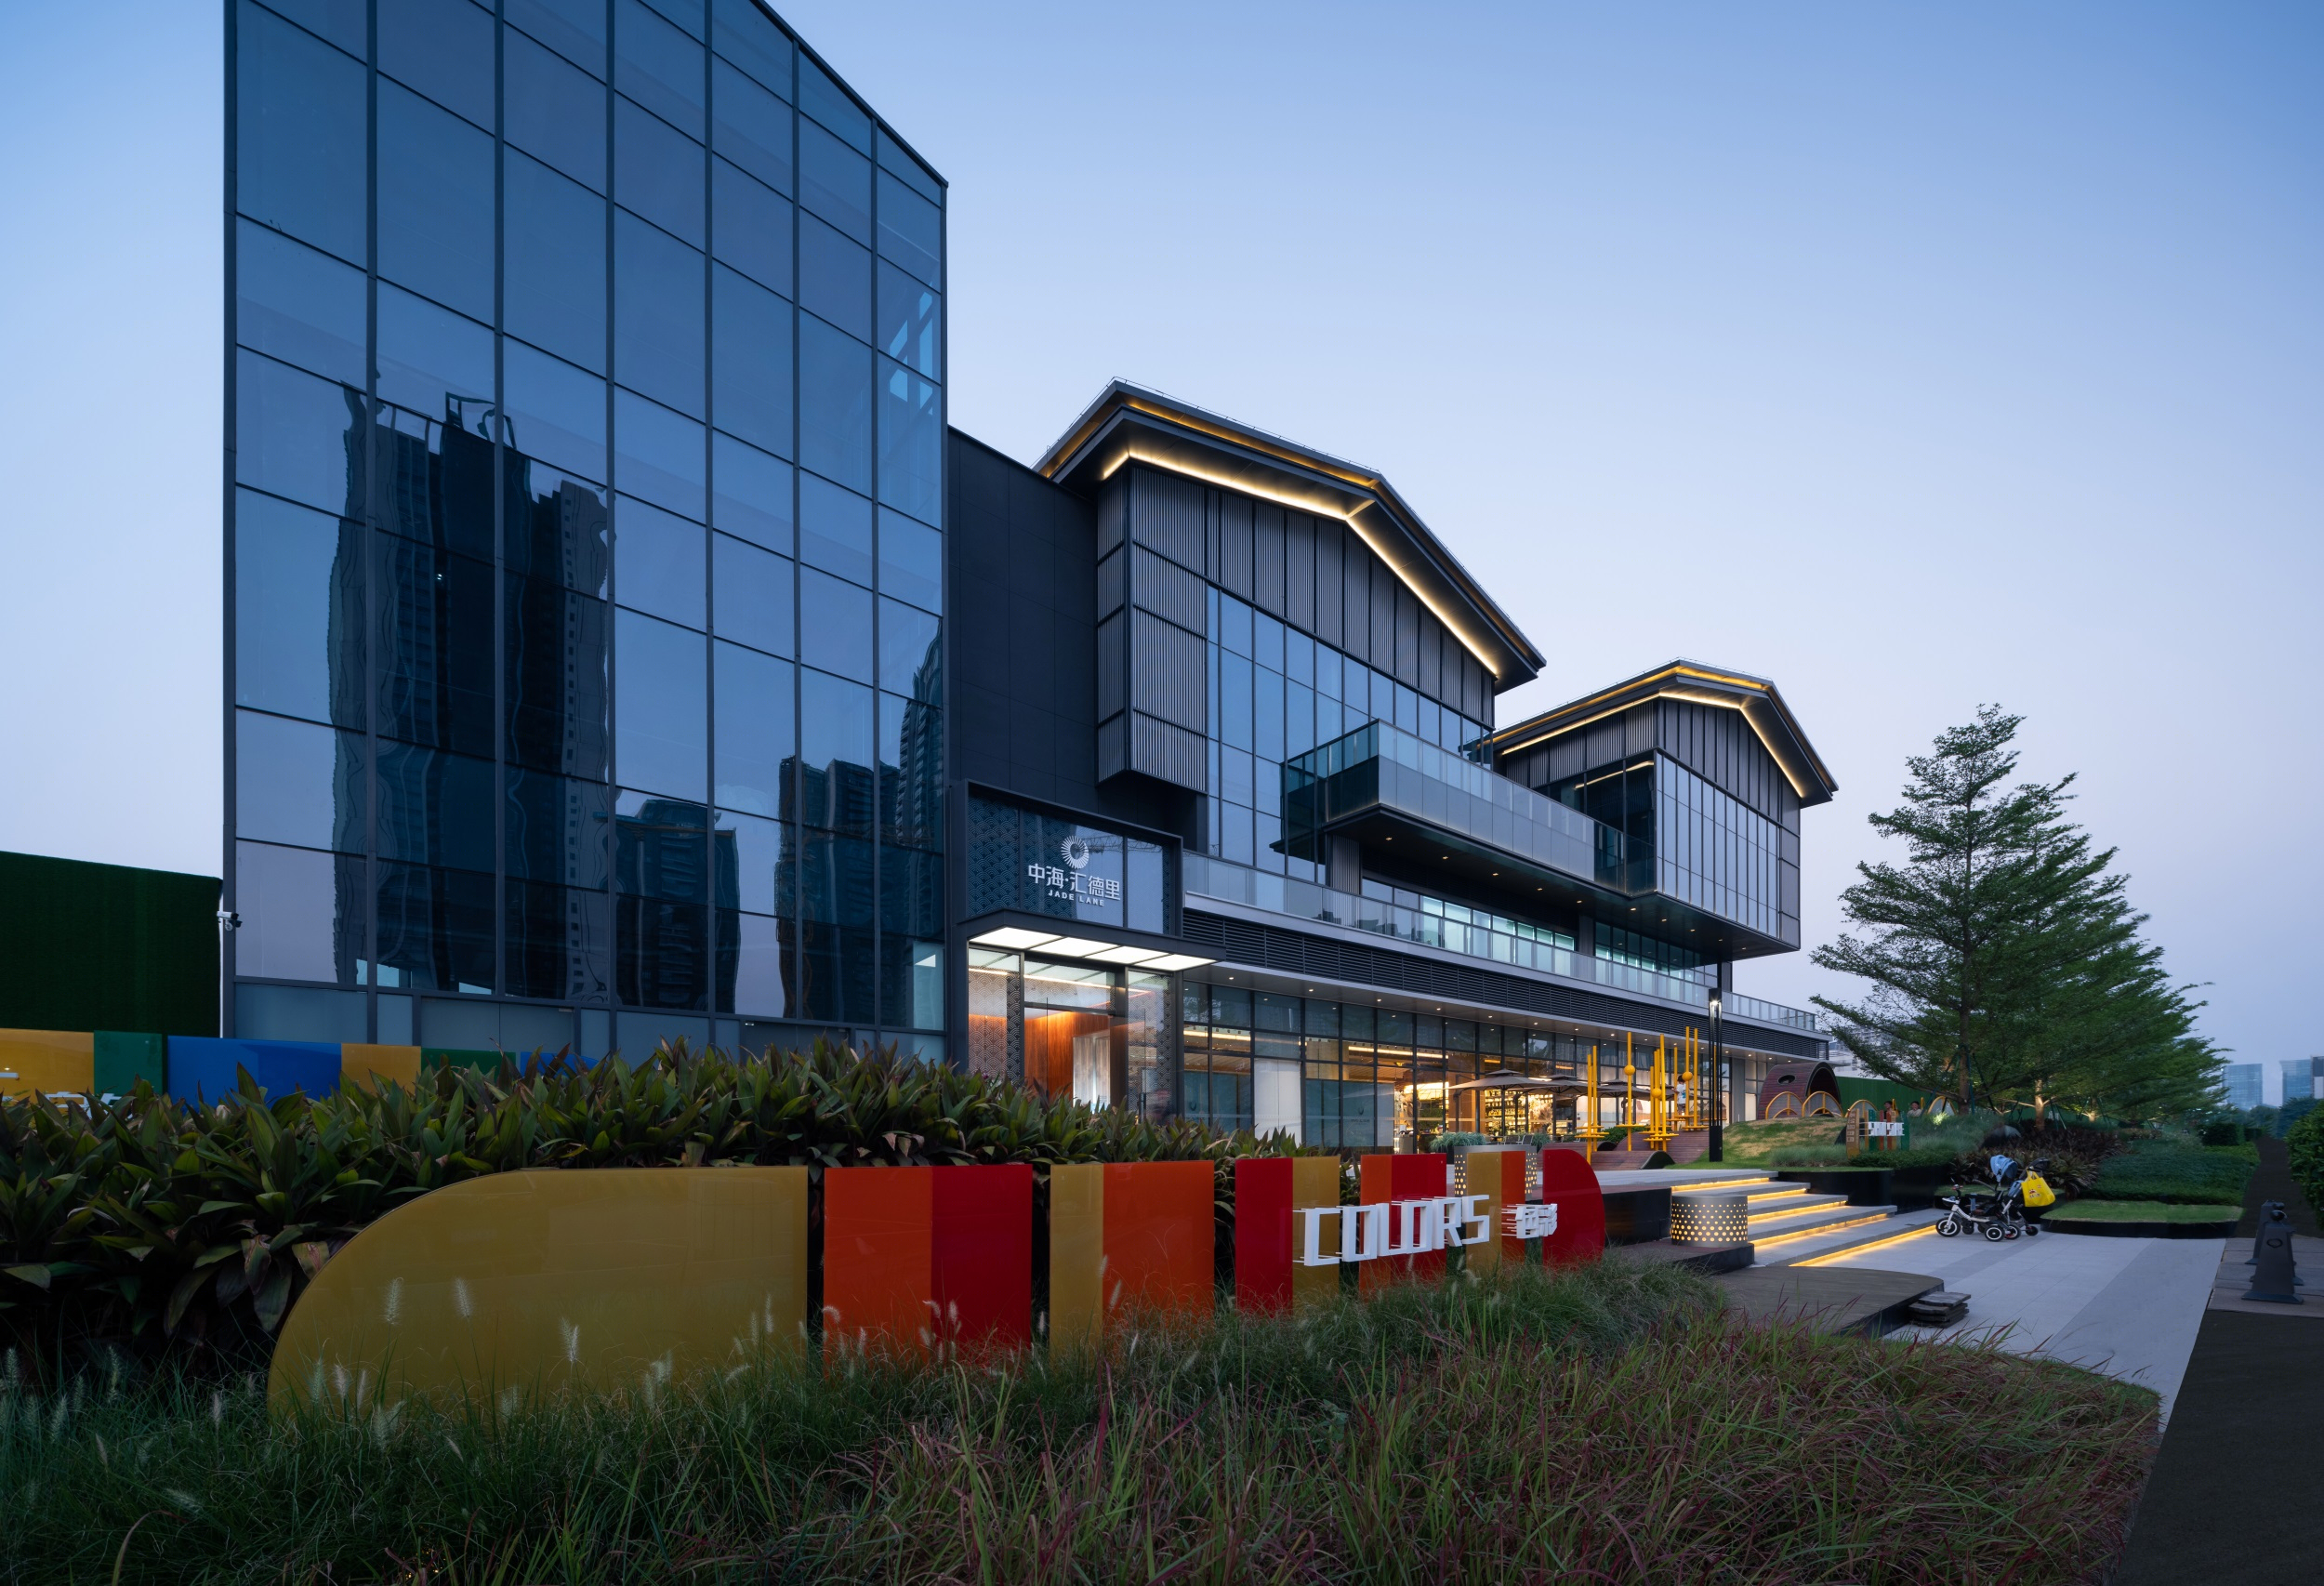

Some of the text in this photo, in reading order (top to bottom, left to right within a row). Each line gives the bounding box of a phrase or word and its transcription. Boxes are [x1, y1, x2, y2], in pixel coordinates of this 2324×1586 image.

[1048, 890, 1105, 906] JADE LANE
[1303, 1195, 1489, 1266] COLORS
